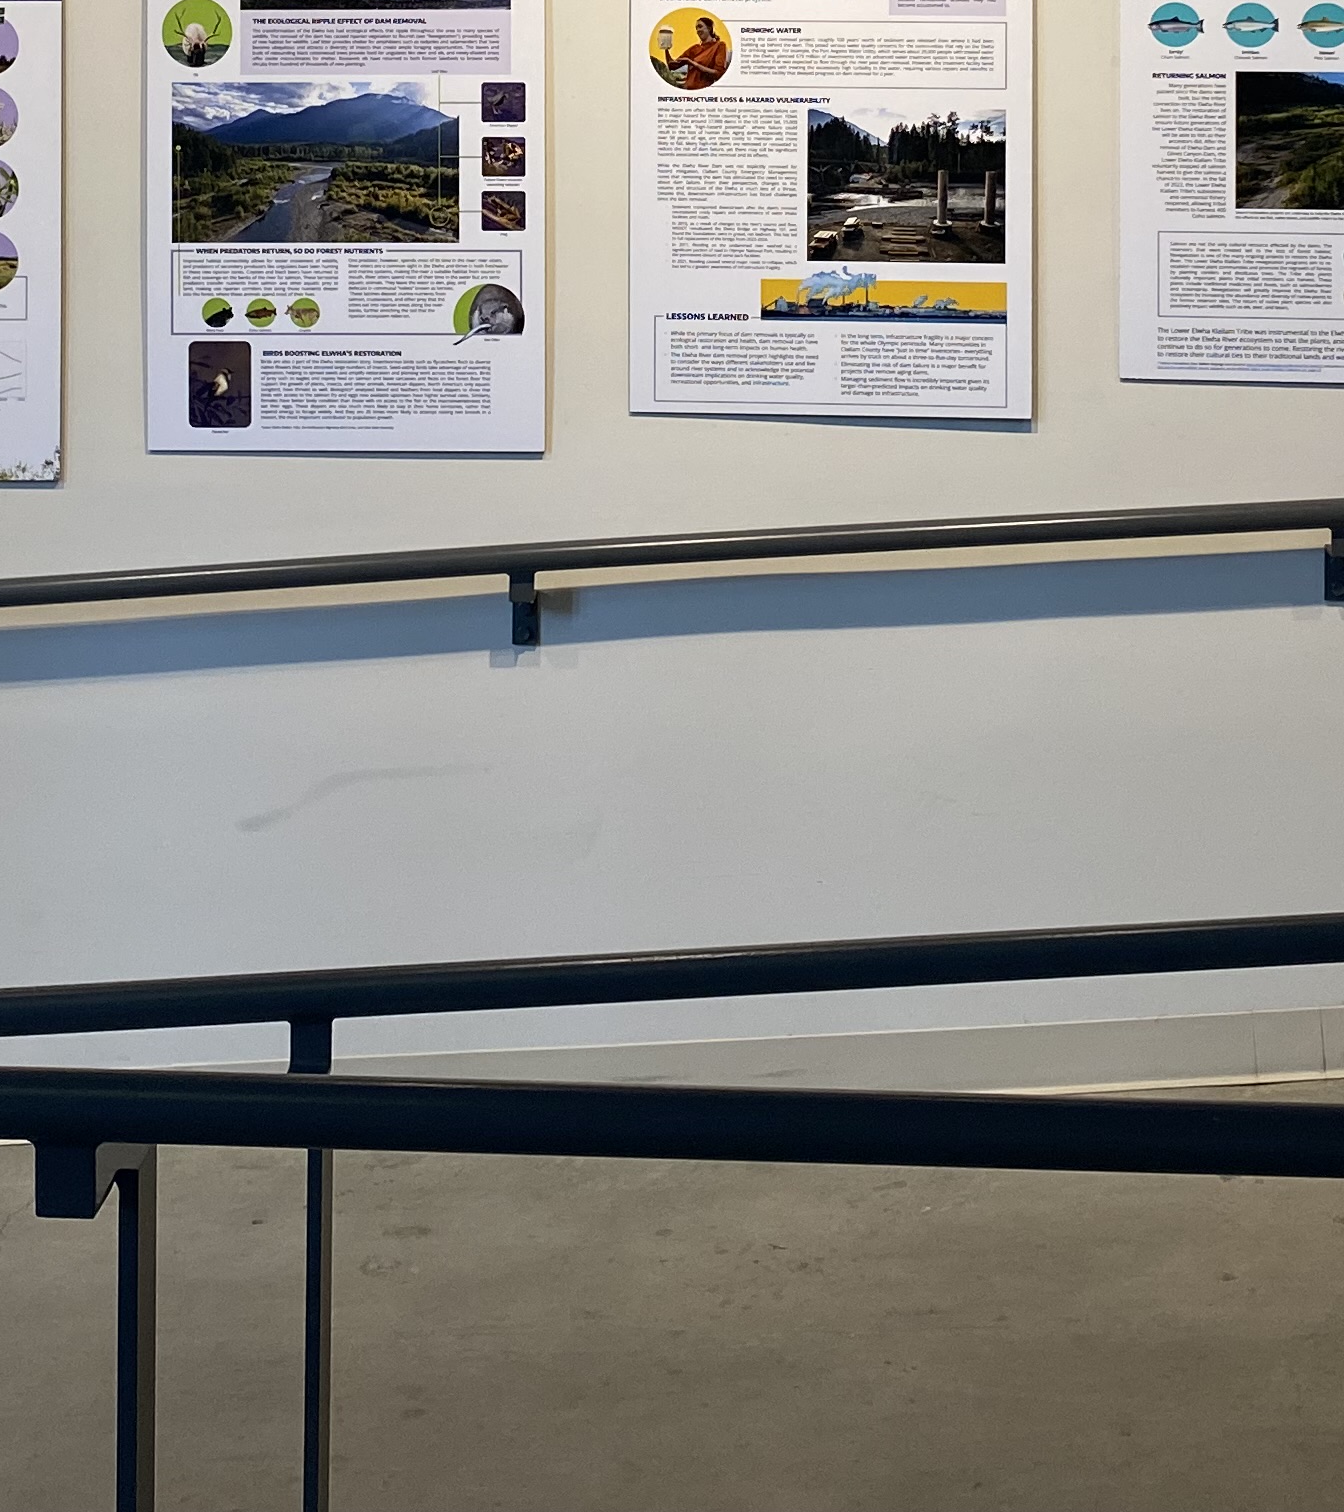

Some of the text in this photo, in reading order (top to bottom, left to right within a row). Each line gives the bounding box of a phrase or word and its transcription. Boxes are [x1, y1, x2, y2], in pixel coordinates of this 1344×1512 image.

[336, 17, 363, 25] EFFECT
[392, 17, 427, 25] REMOVAL
[1152, 72, 1195, 80] RETURNING
[745, 96, 776, 104] HAZARD
[293, 247, 304, 255] SO
[303, 247, 315, 255] DO
[315, 247, 343, 255] FOREST
[343, 247, 384, 255] NUTRIENTS
[665, 312, 750, 322] LESSONS LEARNED
